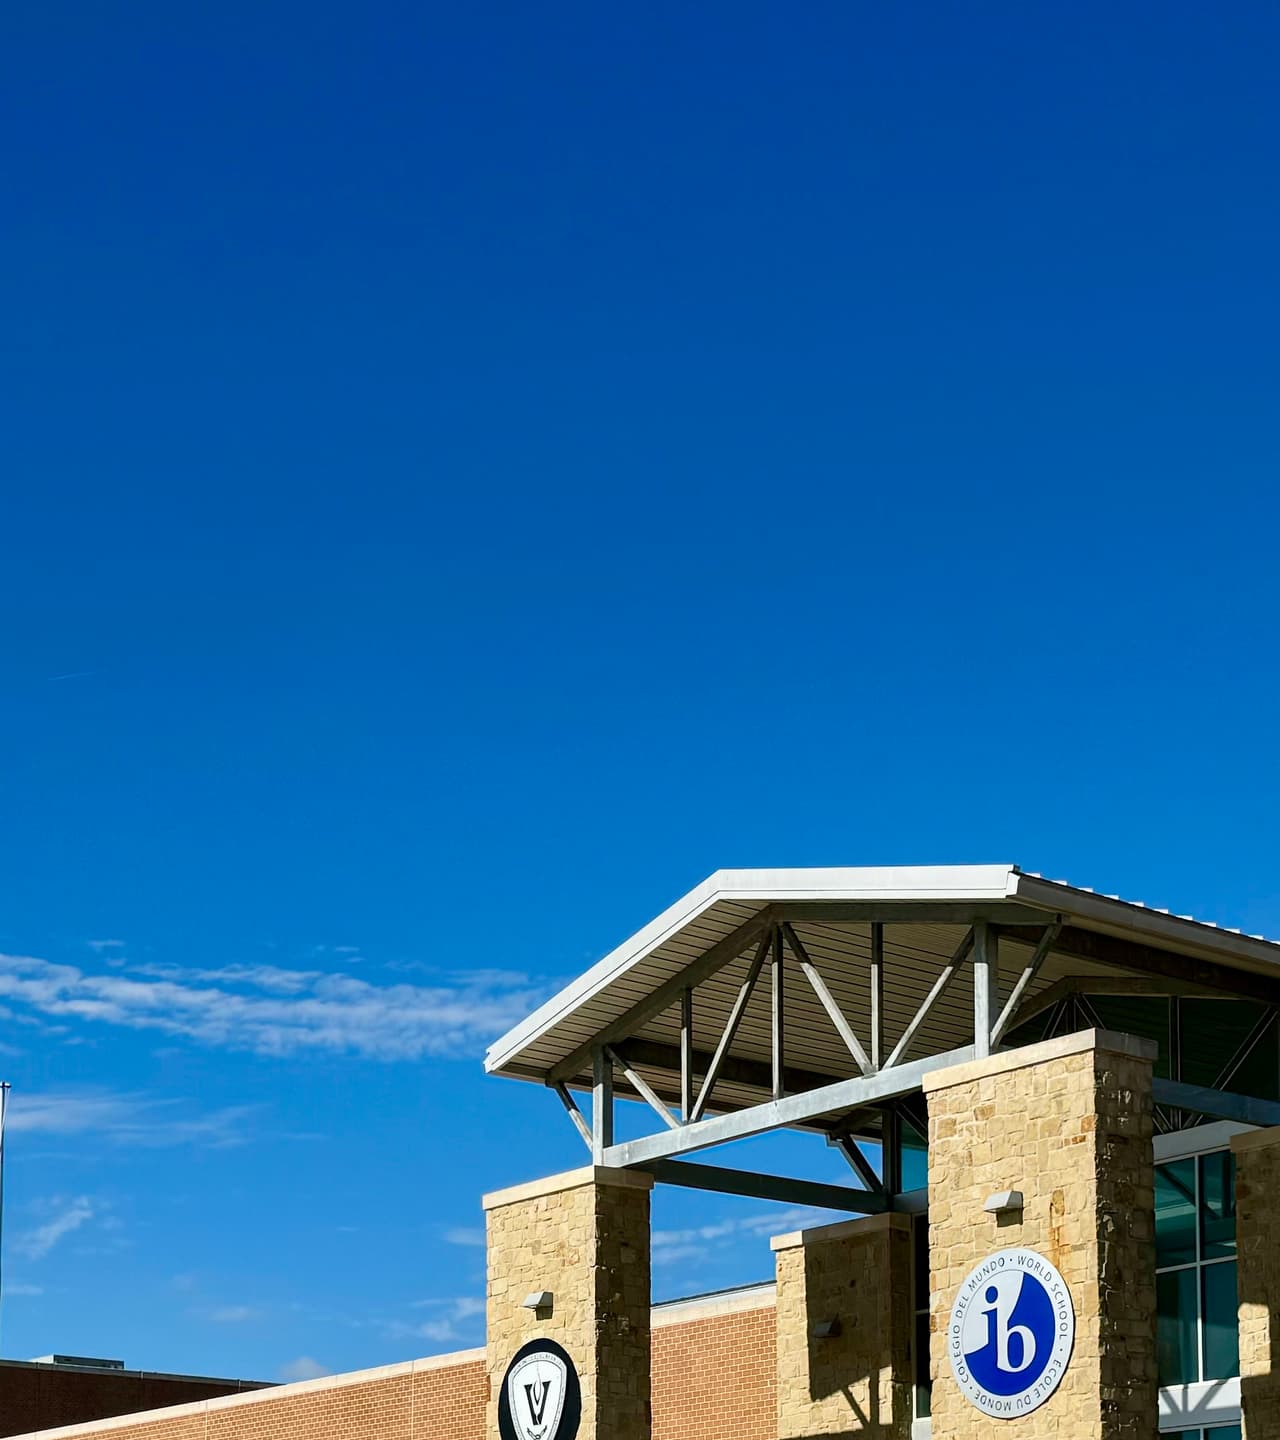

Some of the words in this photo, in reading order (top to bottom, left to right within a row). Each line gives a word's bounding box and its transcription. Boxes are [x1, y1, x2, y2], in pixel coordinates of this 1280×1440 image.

[968, 1257, 1006, 1292] MUNDO
[956, 1295, 970, 1319] DEL
[1017, 1255, 1053, 1282] WORLD
[1050, 1283, 1068, 1340] SCHOOL
[981, 1285, 1036, 1373] ib
[951, 1324, 969, 1384] COLEGIO
[524, 1380, 552, 1426] V
[973, 1389, 1012, 1411] MONDE
[1016, 1395, 1032, 1409] DU
